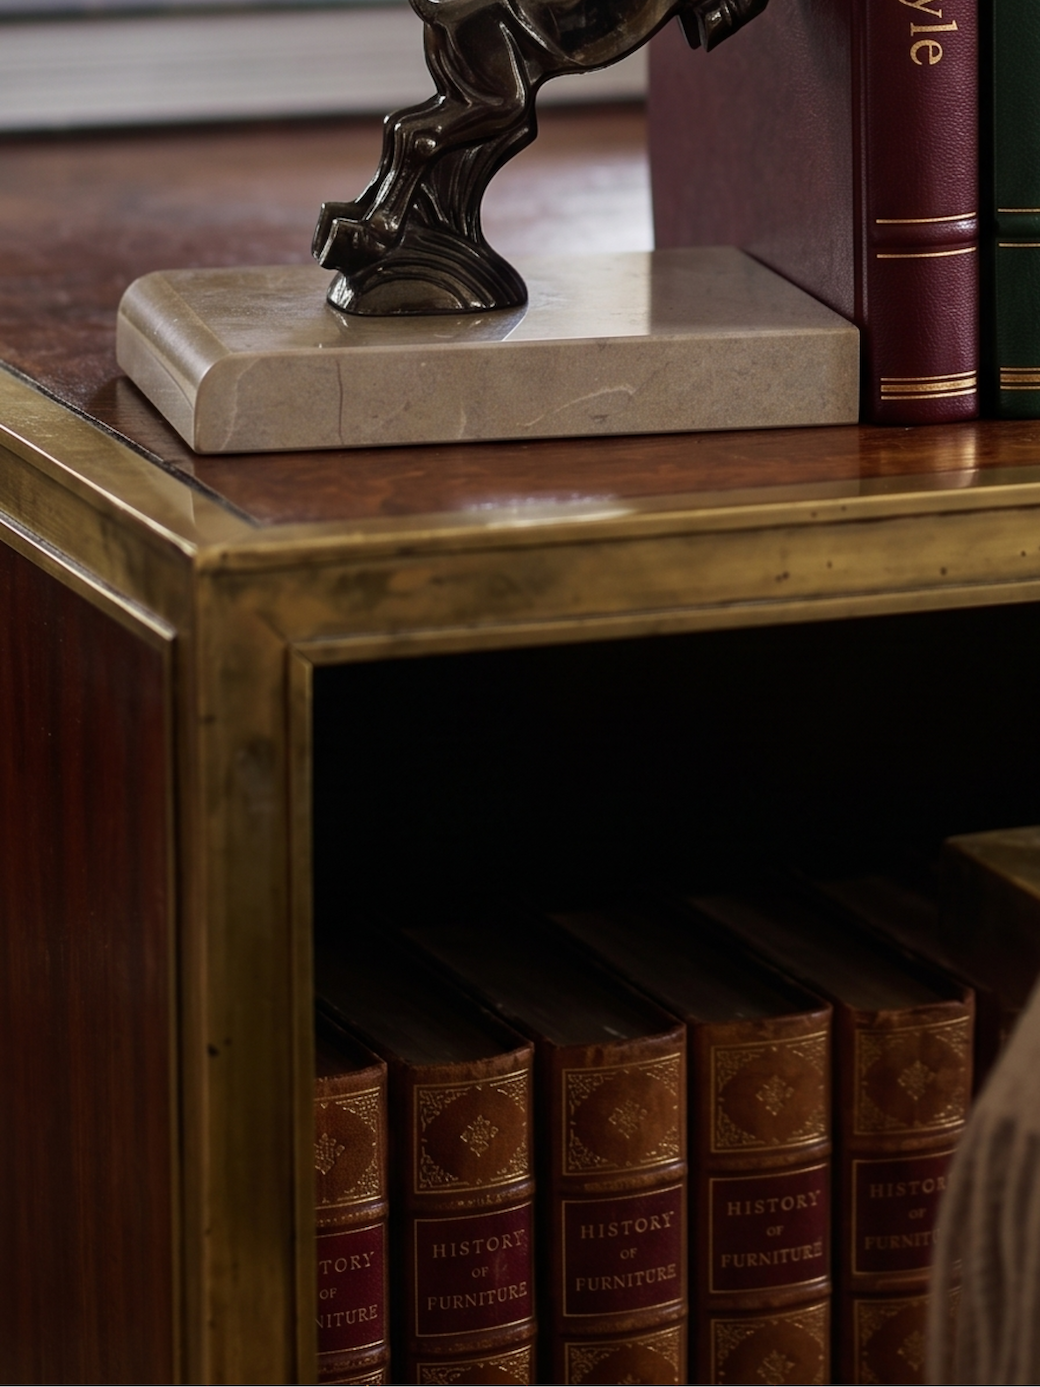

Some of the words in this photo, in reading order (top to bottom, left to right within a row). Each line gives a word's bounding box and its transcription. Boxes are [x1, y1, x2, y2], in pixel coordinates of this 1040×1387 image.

[869, 1176, 947, 1199] HISTOR
[726, 1189, 822, 1216] HISTORY
[580, 1210, 676, 1240] HISTORY
[765, 1224, 785, 1238] OF
[431, 1228, 527, 1260] HISTORY
[619, 1246, 638, 1261] OF
[720, 1240, 823, 1269] FURNITURE
[318, 1250, 376, 1275] TORY
[470, 1265, 490, 1279] OF
[575, 1263, 677, 1292] FURNITURE
[318, 1286, 338, 1301] OF
[426, 1280, 528, 1311] FURNITURE
